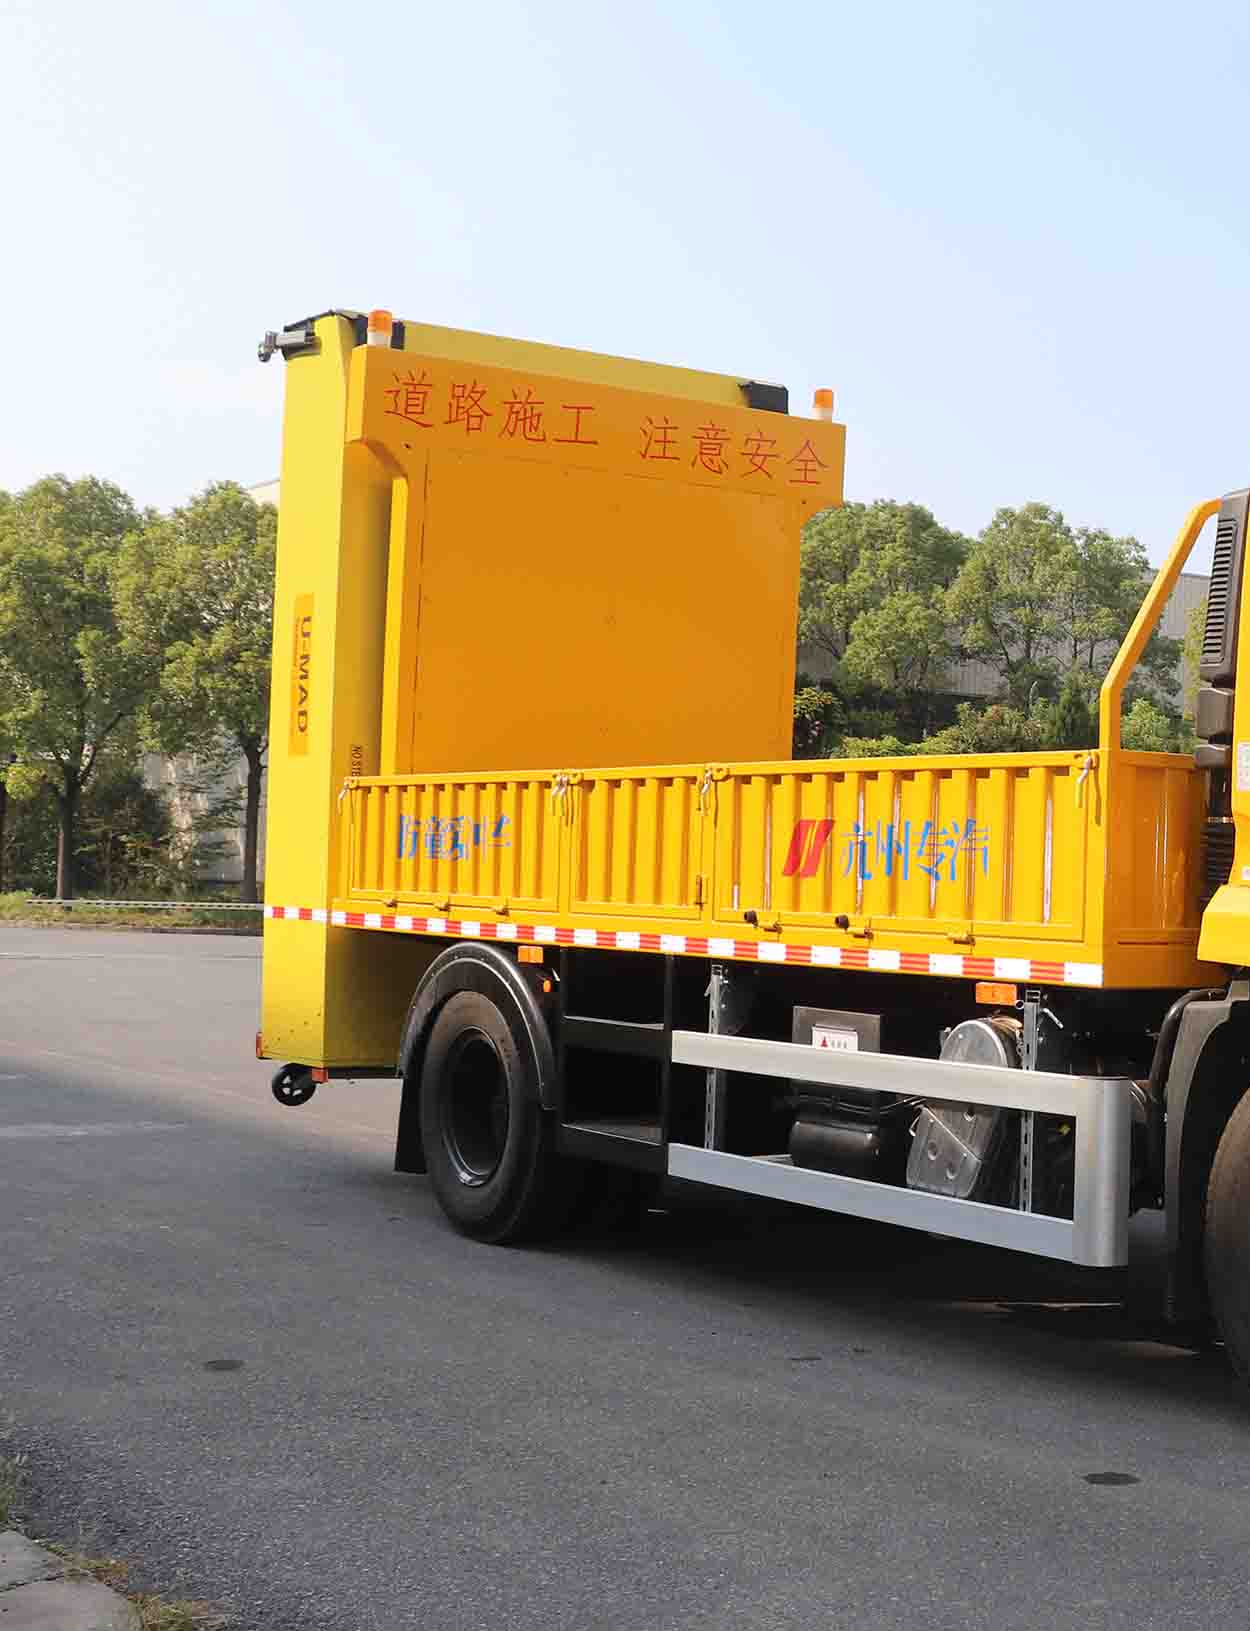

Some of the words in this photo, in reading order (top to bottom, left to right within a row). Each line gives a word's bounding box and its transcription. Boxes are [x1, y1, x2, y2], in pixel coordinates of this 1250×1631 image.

[384, 371, 600, 447] 道路施工
[639, 415, 830, 487] 注意安全
[298, 616, 312, 733] U-MAD
[351, 745, 361, 759] NO
[351, 760, 361, 777] STE
